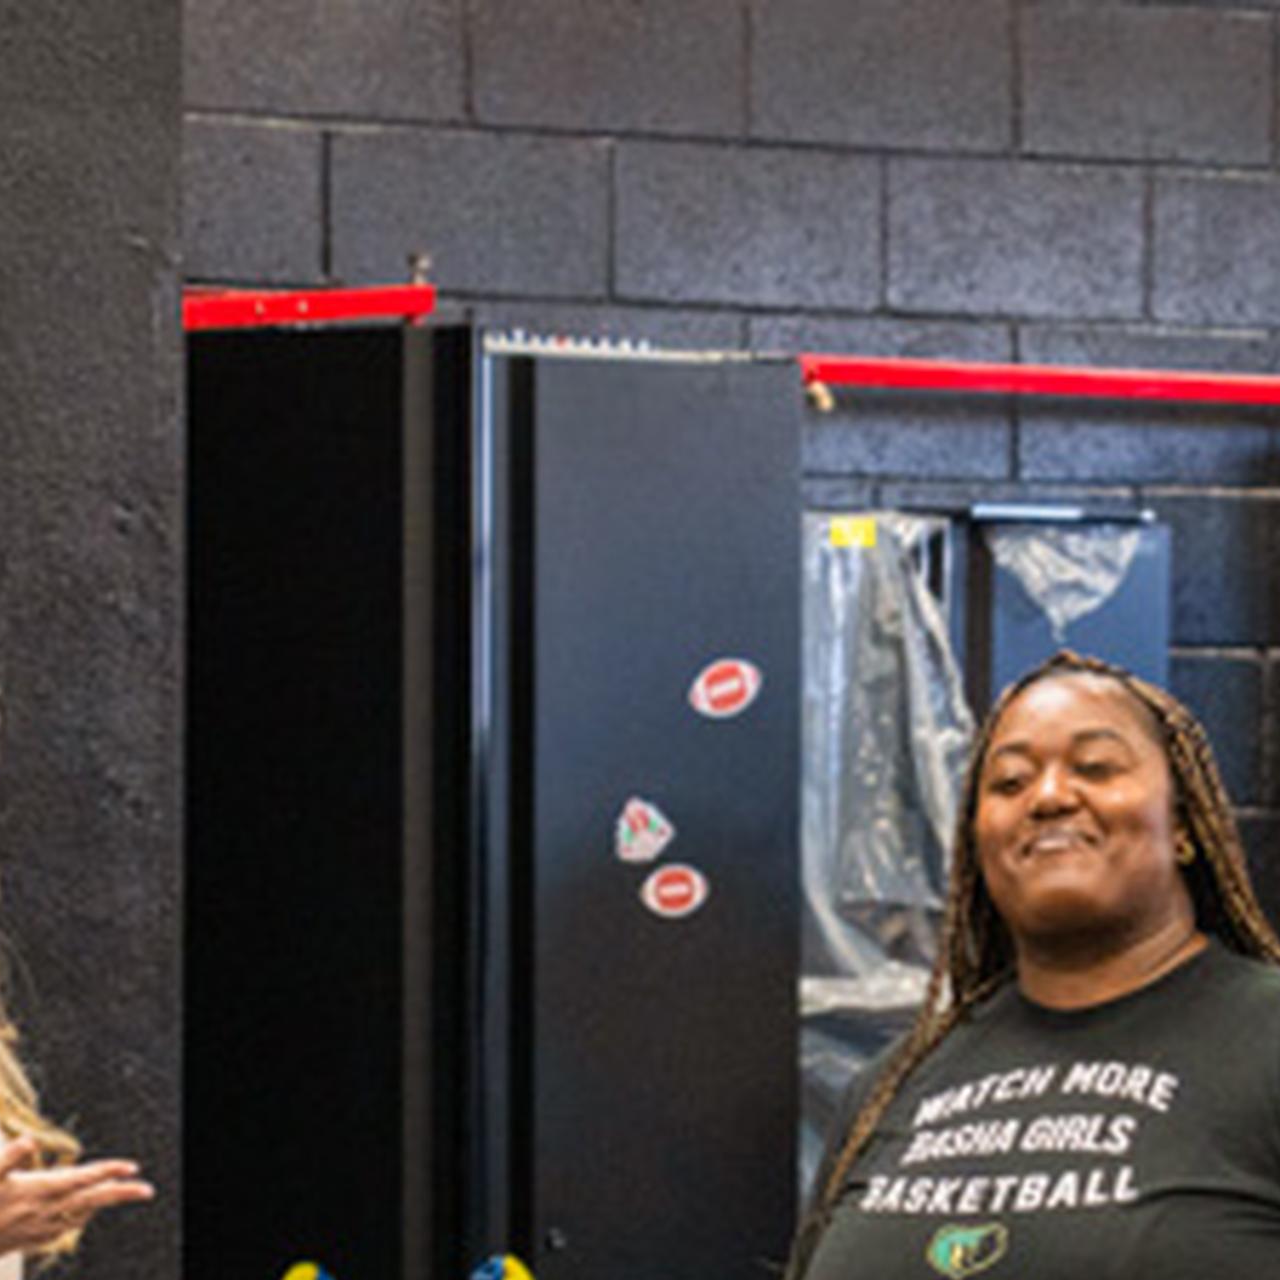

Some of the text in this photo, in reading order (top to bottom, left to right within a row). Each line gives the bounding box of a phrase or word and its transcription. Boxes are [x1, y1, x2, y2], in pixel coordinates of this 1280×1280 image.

[1061, 1060, 1180, 1114] MORE
[1021, 1112, 1139, 1156] GIRLS
[859, 1165, 1141, 1214] BASKETBALL
